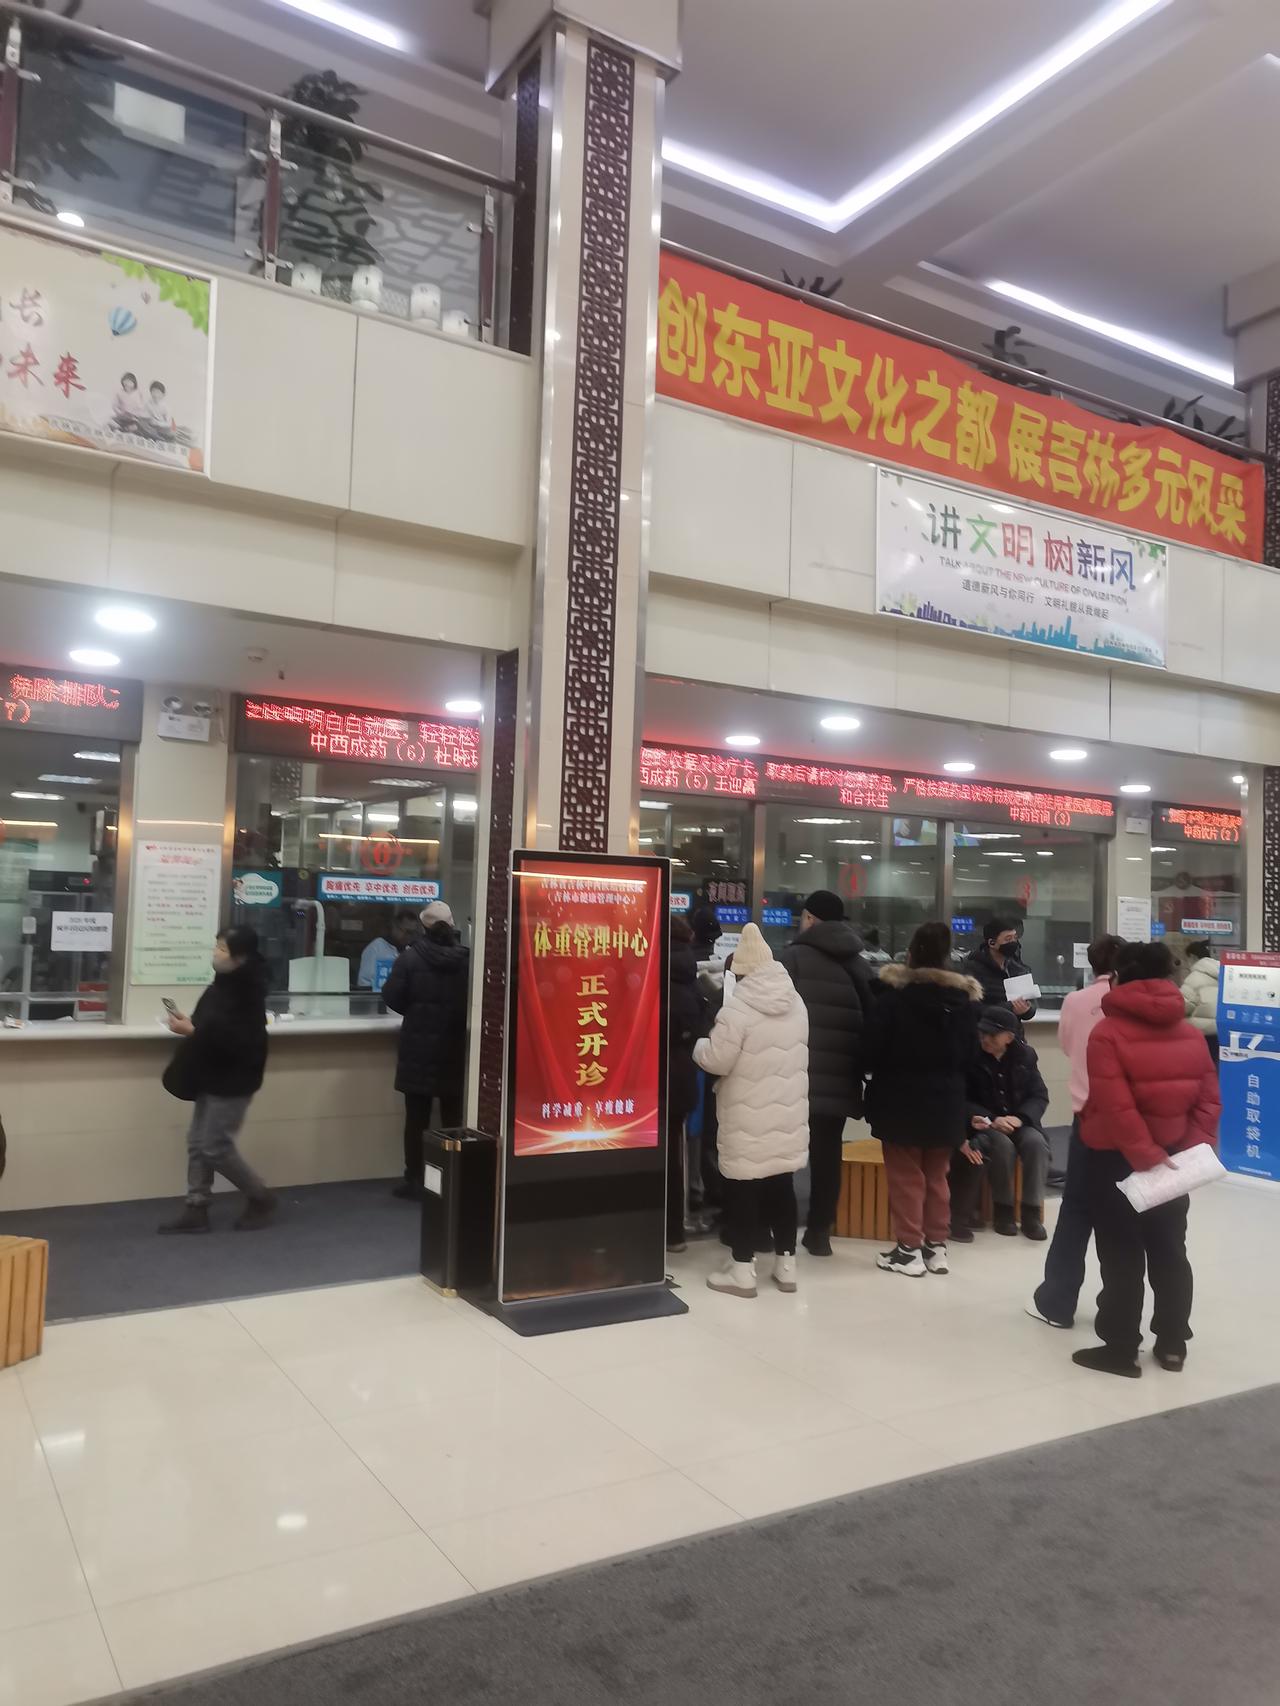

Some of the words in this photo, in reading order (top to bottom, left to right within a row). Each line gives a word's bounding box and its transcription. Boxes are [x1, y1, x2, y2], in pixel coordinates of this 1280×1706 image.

[0, 288, 43, 327] 长
[0, 343, 87, 399] 未来
[658, 277, 999, 471] 创东亚文化之都
[1008, 402, 1247, 544] 展吉林多元风采
[926, 502, 1035, 567] 讲文明
[1043, 530, 1137, 592] 树新风
[995, 567, 1012, 581] THE
[533, 920, 649, 959] 体重管理中心
[574, 974, 609, 1087] 正式开诊
